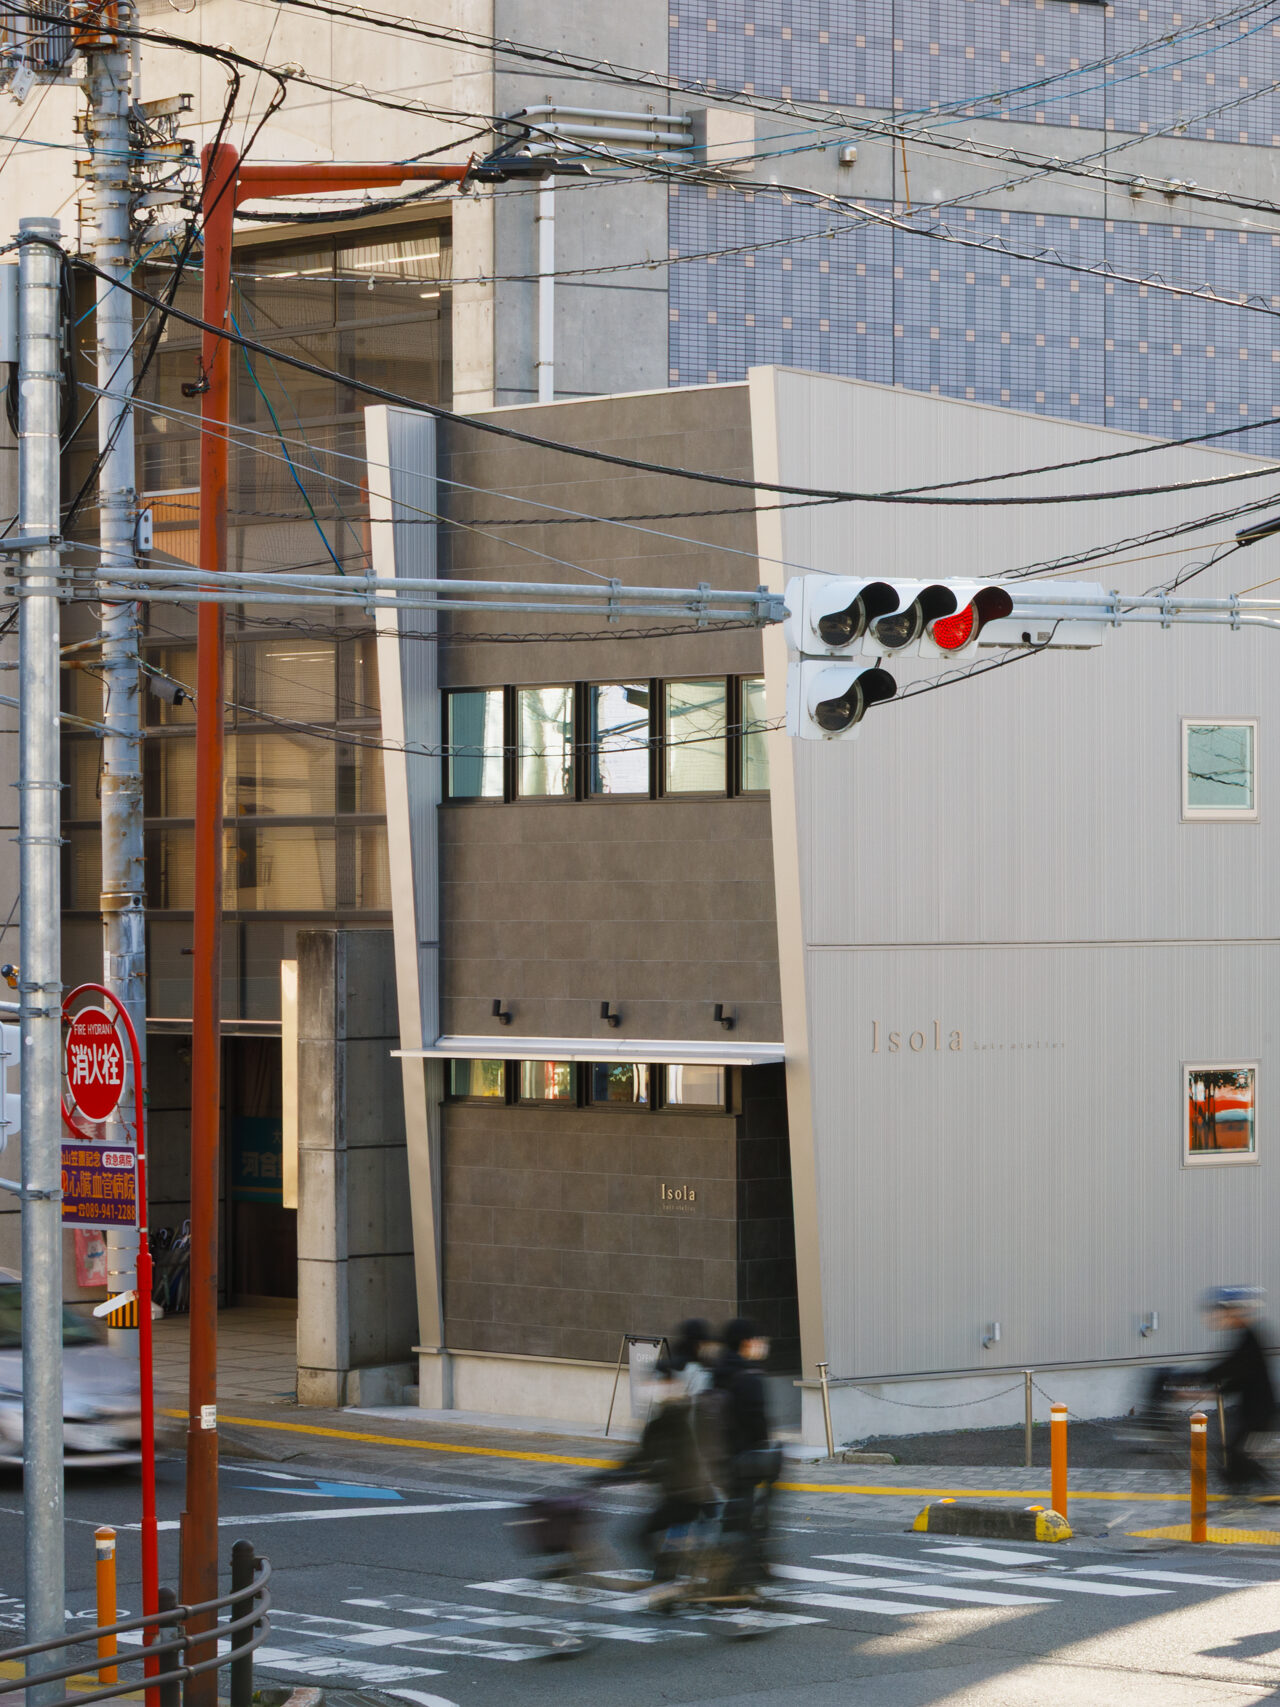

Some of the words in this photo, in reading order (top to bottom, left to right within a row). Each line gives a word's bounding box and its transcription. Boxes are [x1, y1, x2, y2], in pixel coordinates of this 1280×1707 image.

[73, 1024, 87, 1036] FIRE
[87, 1024, 113, 1036] HYDRANT
[871, 1019, 964, 1053] Isola
[71, 1043, 121, 1085] 消火栓
[62, 1149, 101, 1168] 山笠置記念
[241, 1151, 282, 1178] 河合
[661, 1183, 696, 1201] Isola
